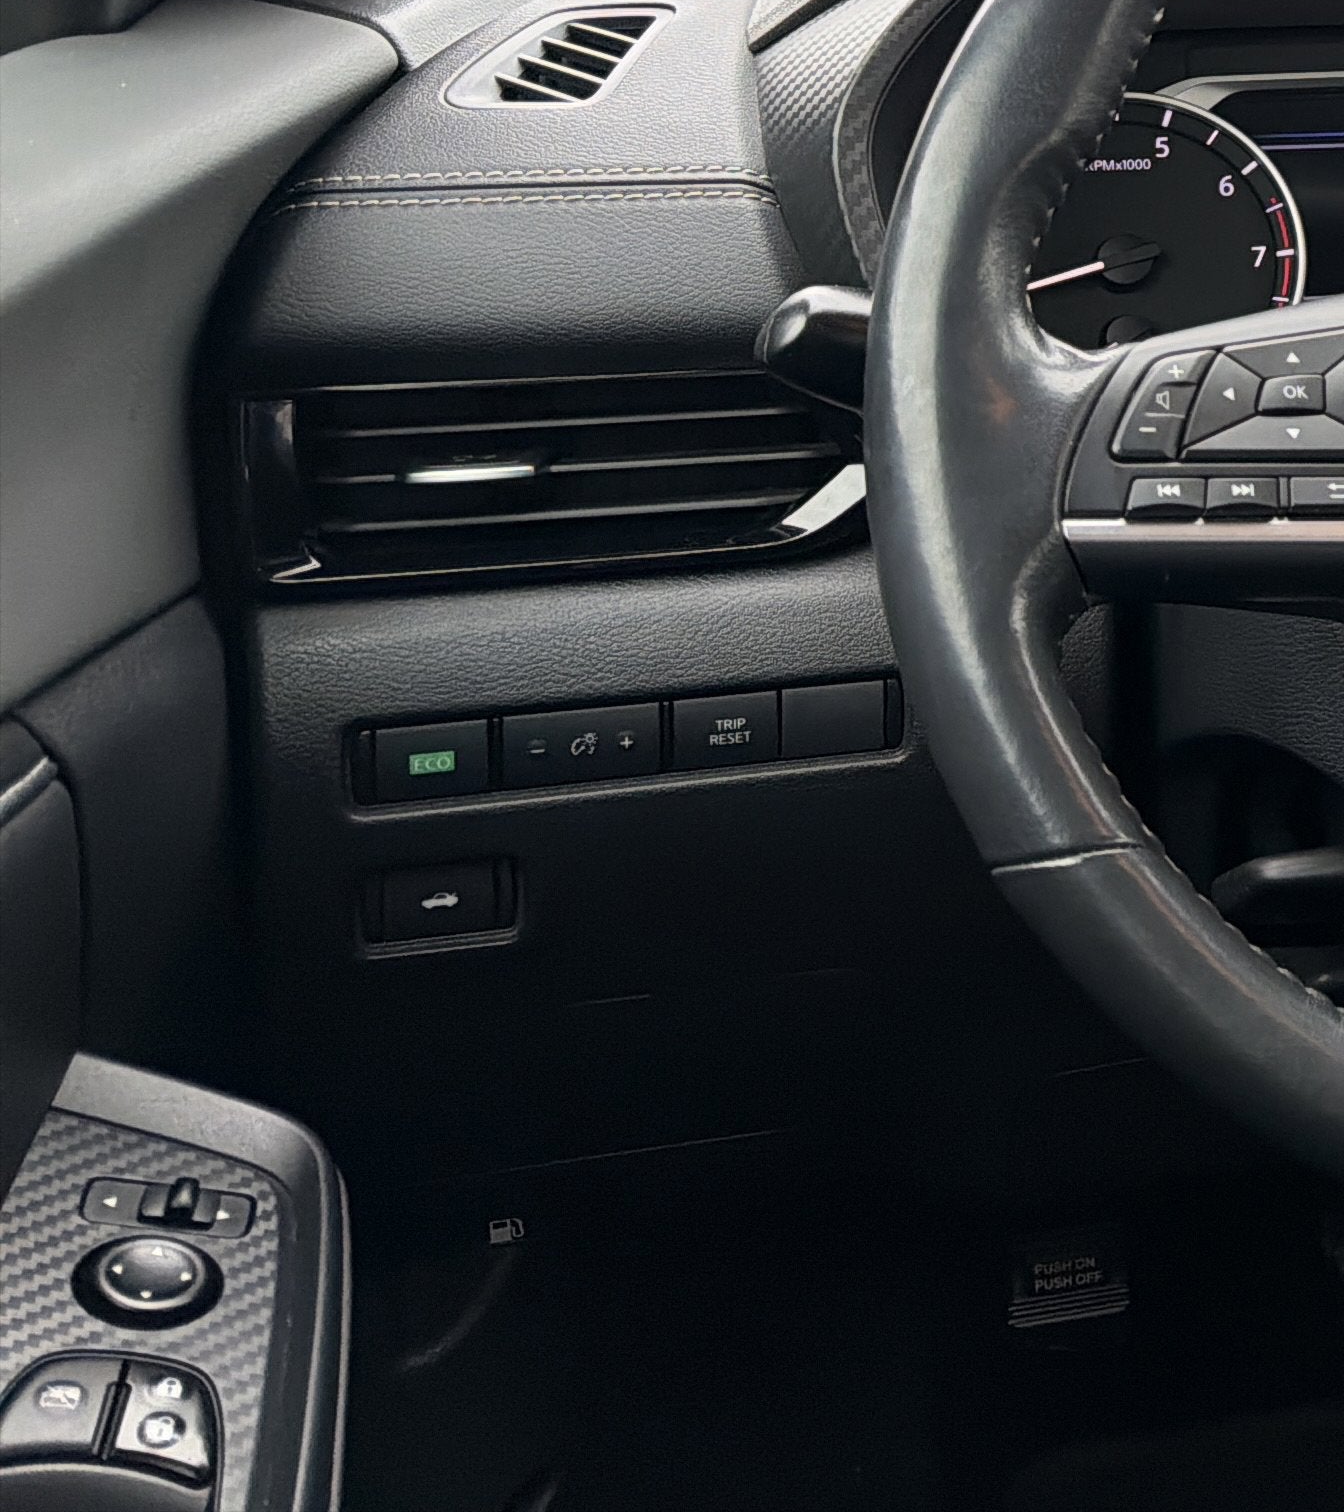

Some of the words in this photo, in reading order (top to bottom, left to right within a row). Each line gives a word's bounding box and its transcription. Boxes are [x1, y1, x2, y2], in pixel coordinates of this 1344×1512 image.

[1155, 137, 1170, 158] 5
[1218, 175, 1235, 197] 6
[1250, 245, 1267, 268] 7
[1282, 385, 1309, 400] OK
[716, 716, 747, 732] TRIP
[709, 730, 752, 746] RESET
[413, 754, 452, 772] ECO
[1034, 1261, 1072, 1276] PUSH
[1075, 1256, 1096, 1270] ON
[1034, 1276, 1073, 1293] PUSH
[1075, 1270, 1104, 1286] OFF
